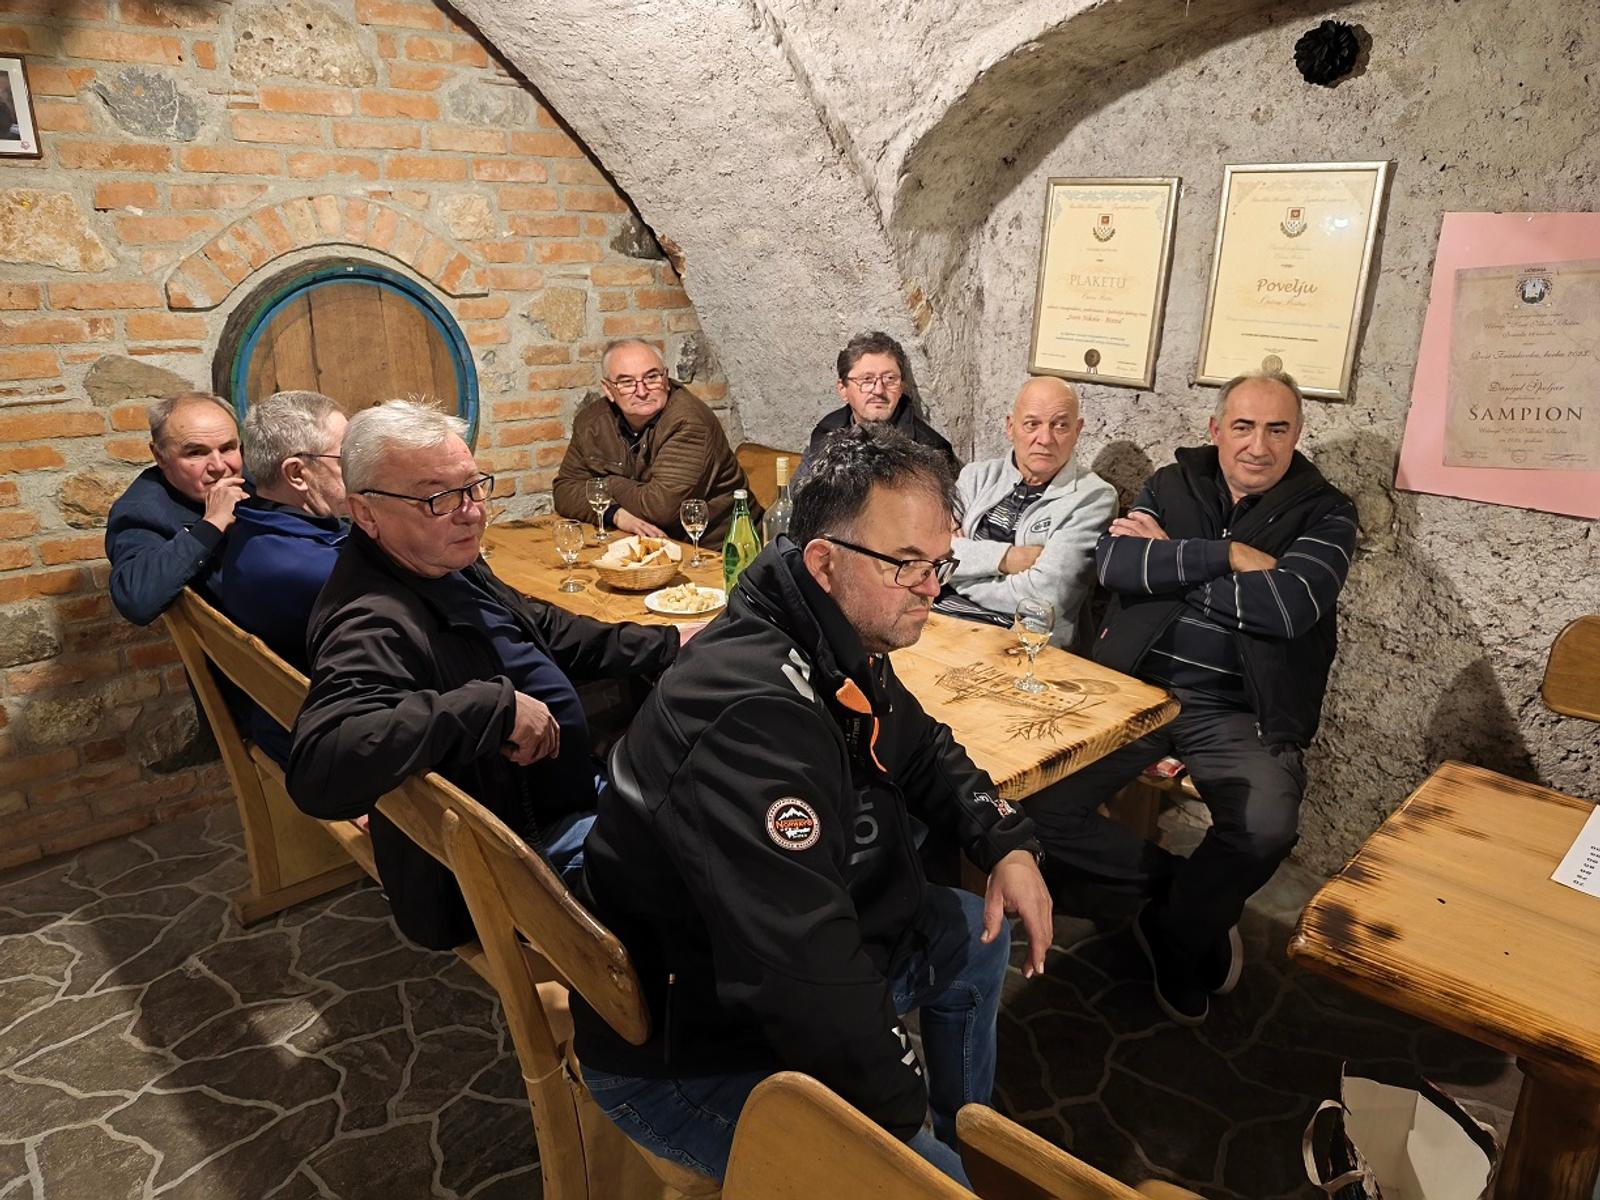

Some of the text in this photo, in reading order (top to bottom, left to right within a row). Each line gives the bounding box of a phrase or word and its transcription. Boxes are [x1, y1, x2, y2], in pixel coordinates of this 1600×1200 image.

[1069, 274, 1127, 289] PLAKETU
[1256, 278, 1319, 298] Povelju
[1468, 403, 1583, 421] ŠAMPION
